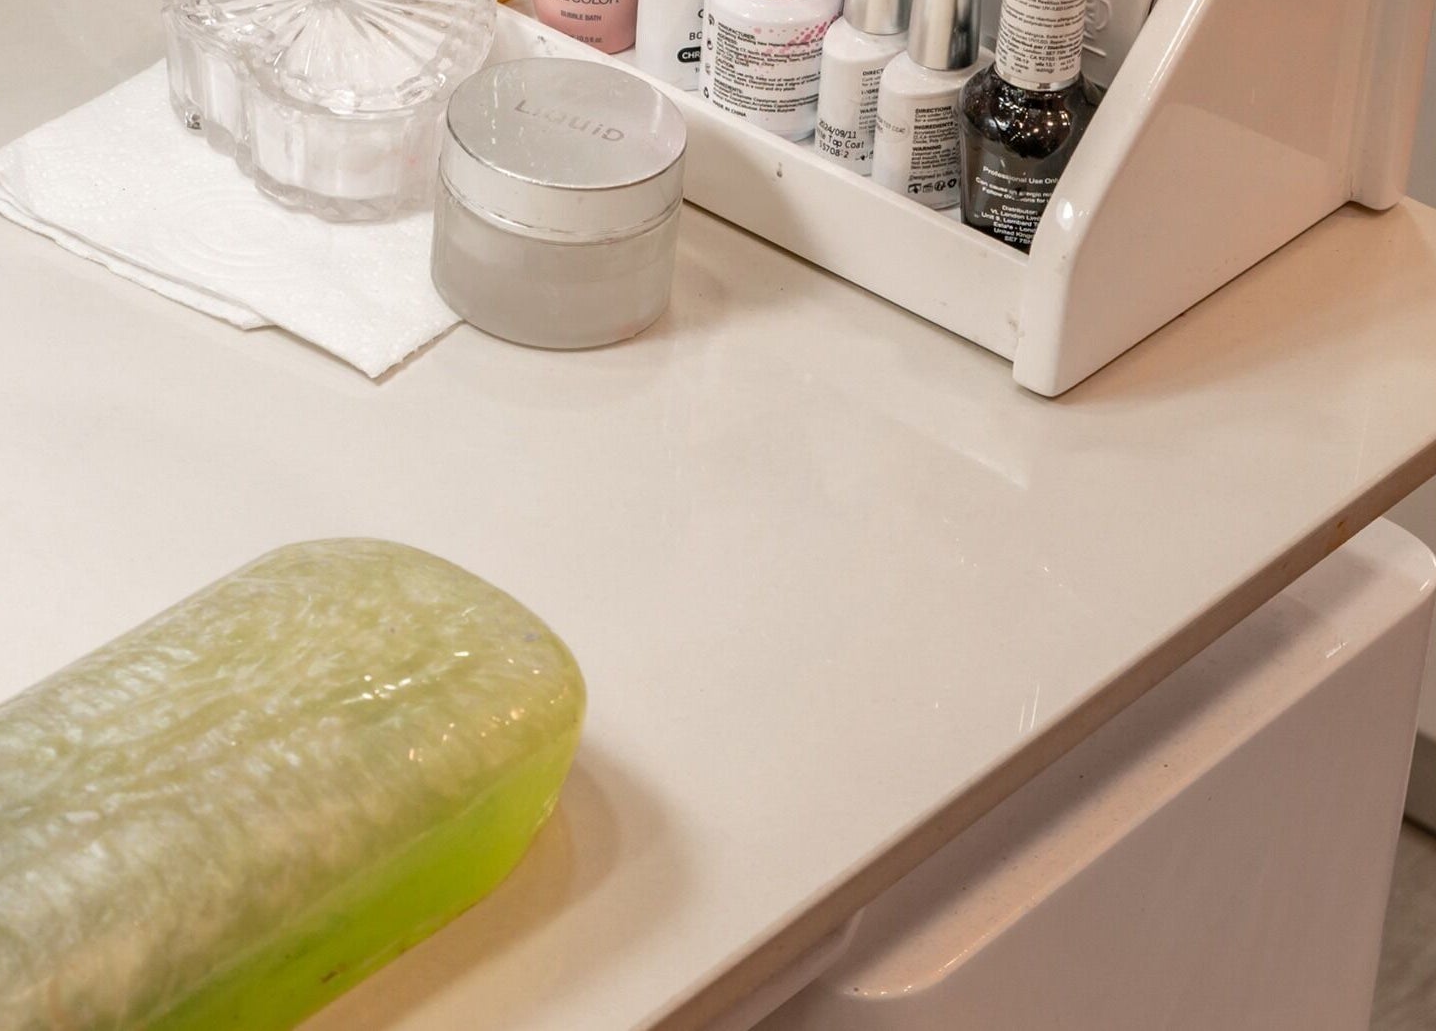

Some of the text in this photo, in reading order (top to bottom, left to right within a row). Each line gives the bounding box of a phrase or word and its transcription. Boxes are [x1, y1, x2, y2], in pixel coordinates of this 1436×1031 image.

[584, 14, 603, 22] BATH
[983, 165, 1027, 184] Professional
[1028, 177, 1043, 185] Use
